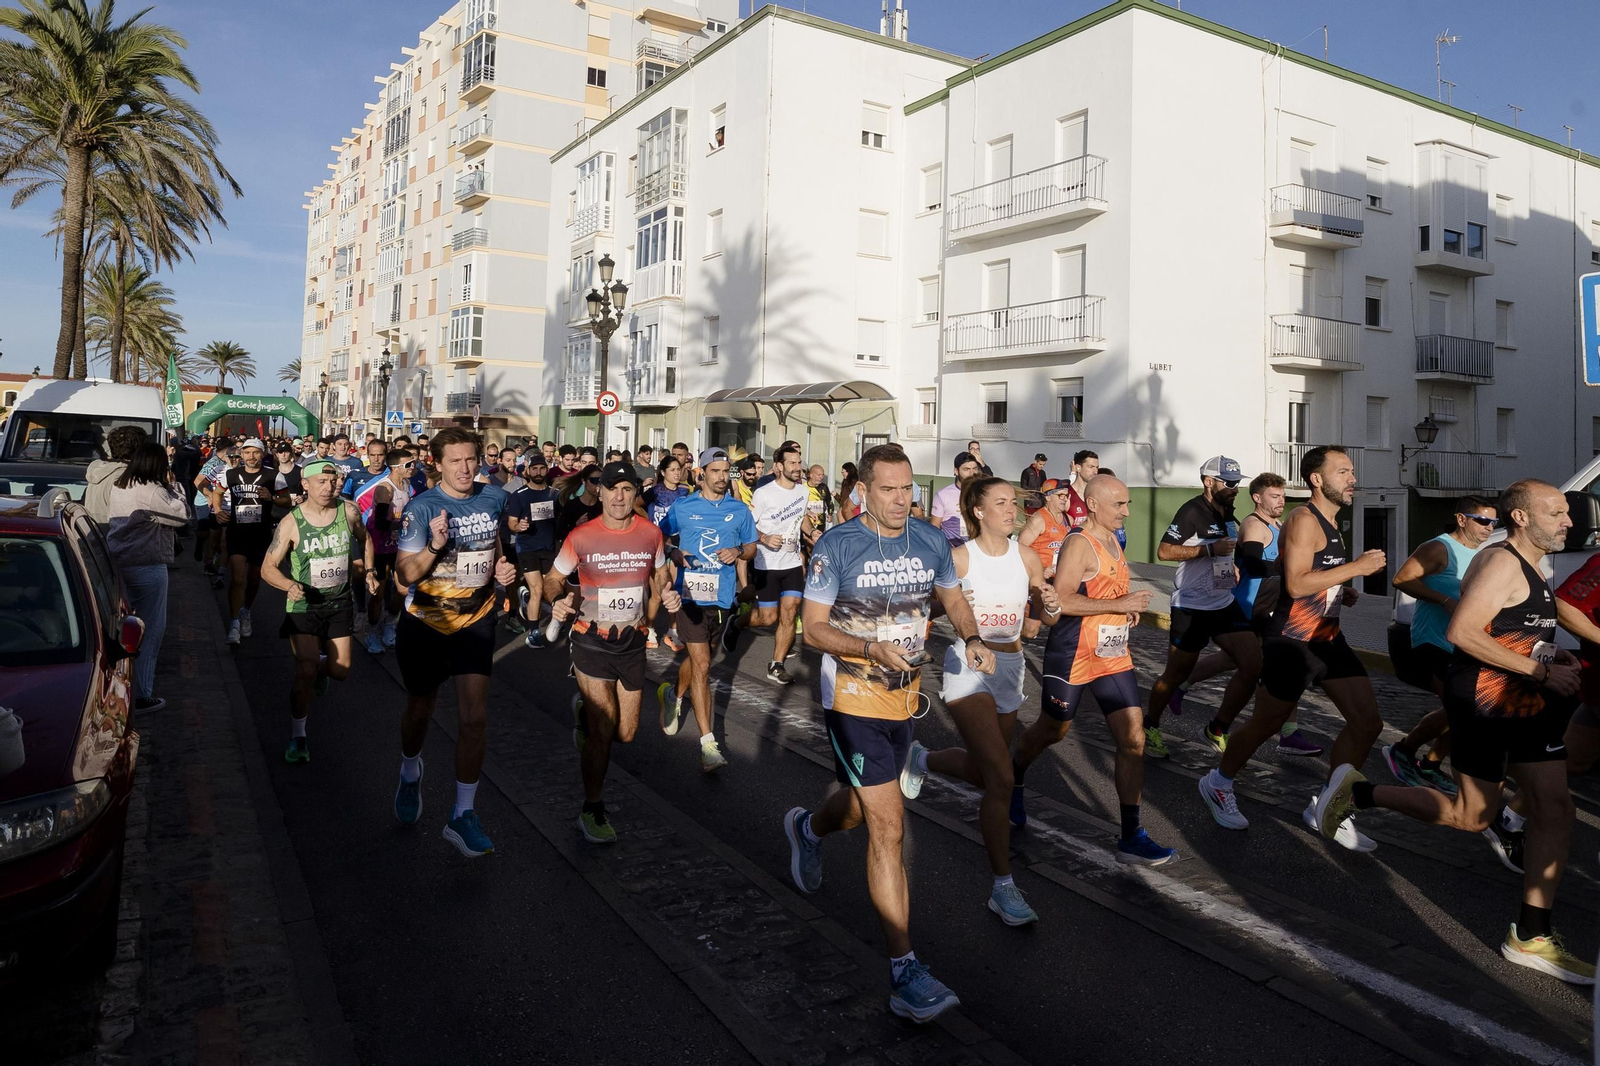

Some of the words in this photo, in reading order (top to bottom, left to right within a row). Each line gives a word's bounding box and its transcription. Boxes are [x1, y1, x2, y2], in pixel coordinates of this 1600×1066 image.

[1149, 362, 1173, 371] LUBET
[236, 400, 257, 409] Corte
[256, 399, 286, 413] Inglés
[602, 398, 615, 407] 30
[231, 484, 262, 495] KENIAT
[536, 506, 550, 514] 795
[770, 510, 783, 520] San
[782, 495, 805, 514] Jerónimo
[780, 506, 803, 522] Alamillo
[302, 530, 350, 554] JAIRA
[597, 561, 620, 570] Ciudad
[630, 560, 647, 568] Cádiz
[864, 556, 923, 574] media
[320, 567, 343, 579] 636
[856, 568, 935, 589] maraton
[687, 581, 715, 593] 2138
[881, 585, 906, 595] CIUDAD
[909, 584, 917, 592] DE
[608, 597, 635, 611] 492
[979, 613, 1018, 627] 2389
[1103, 634, 1127, 648] 2531
